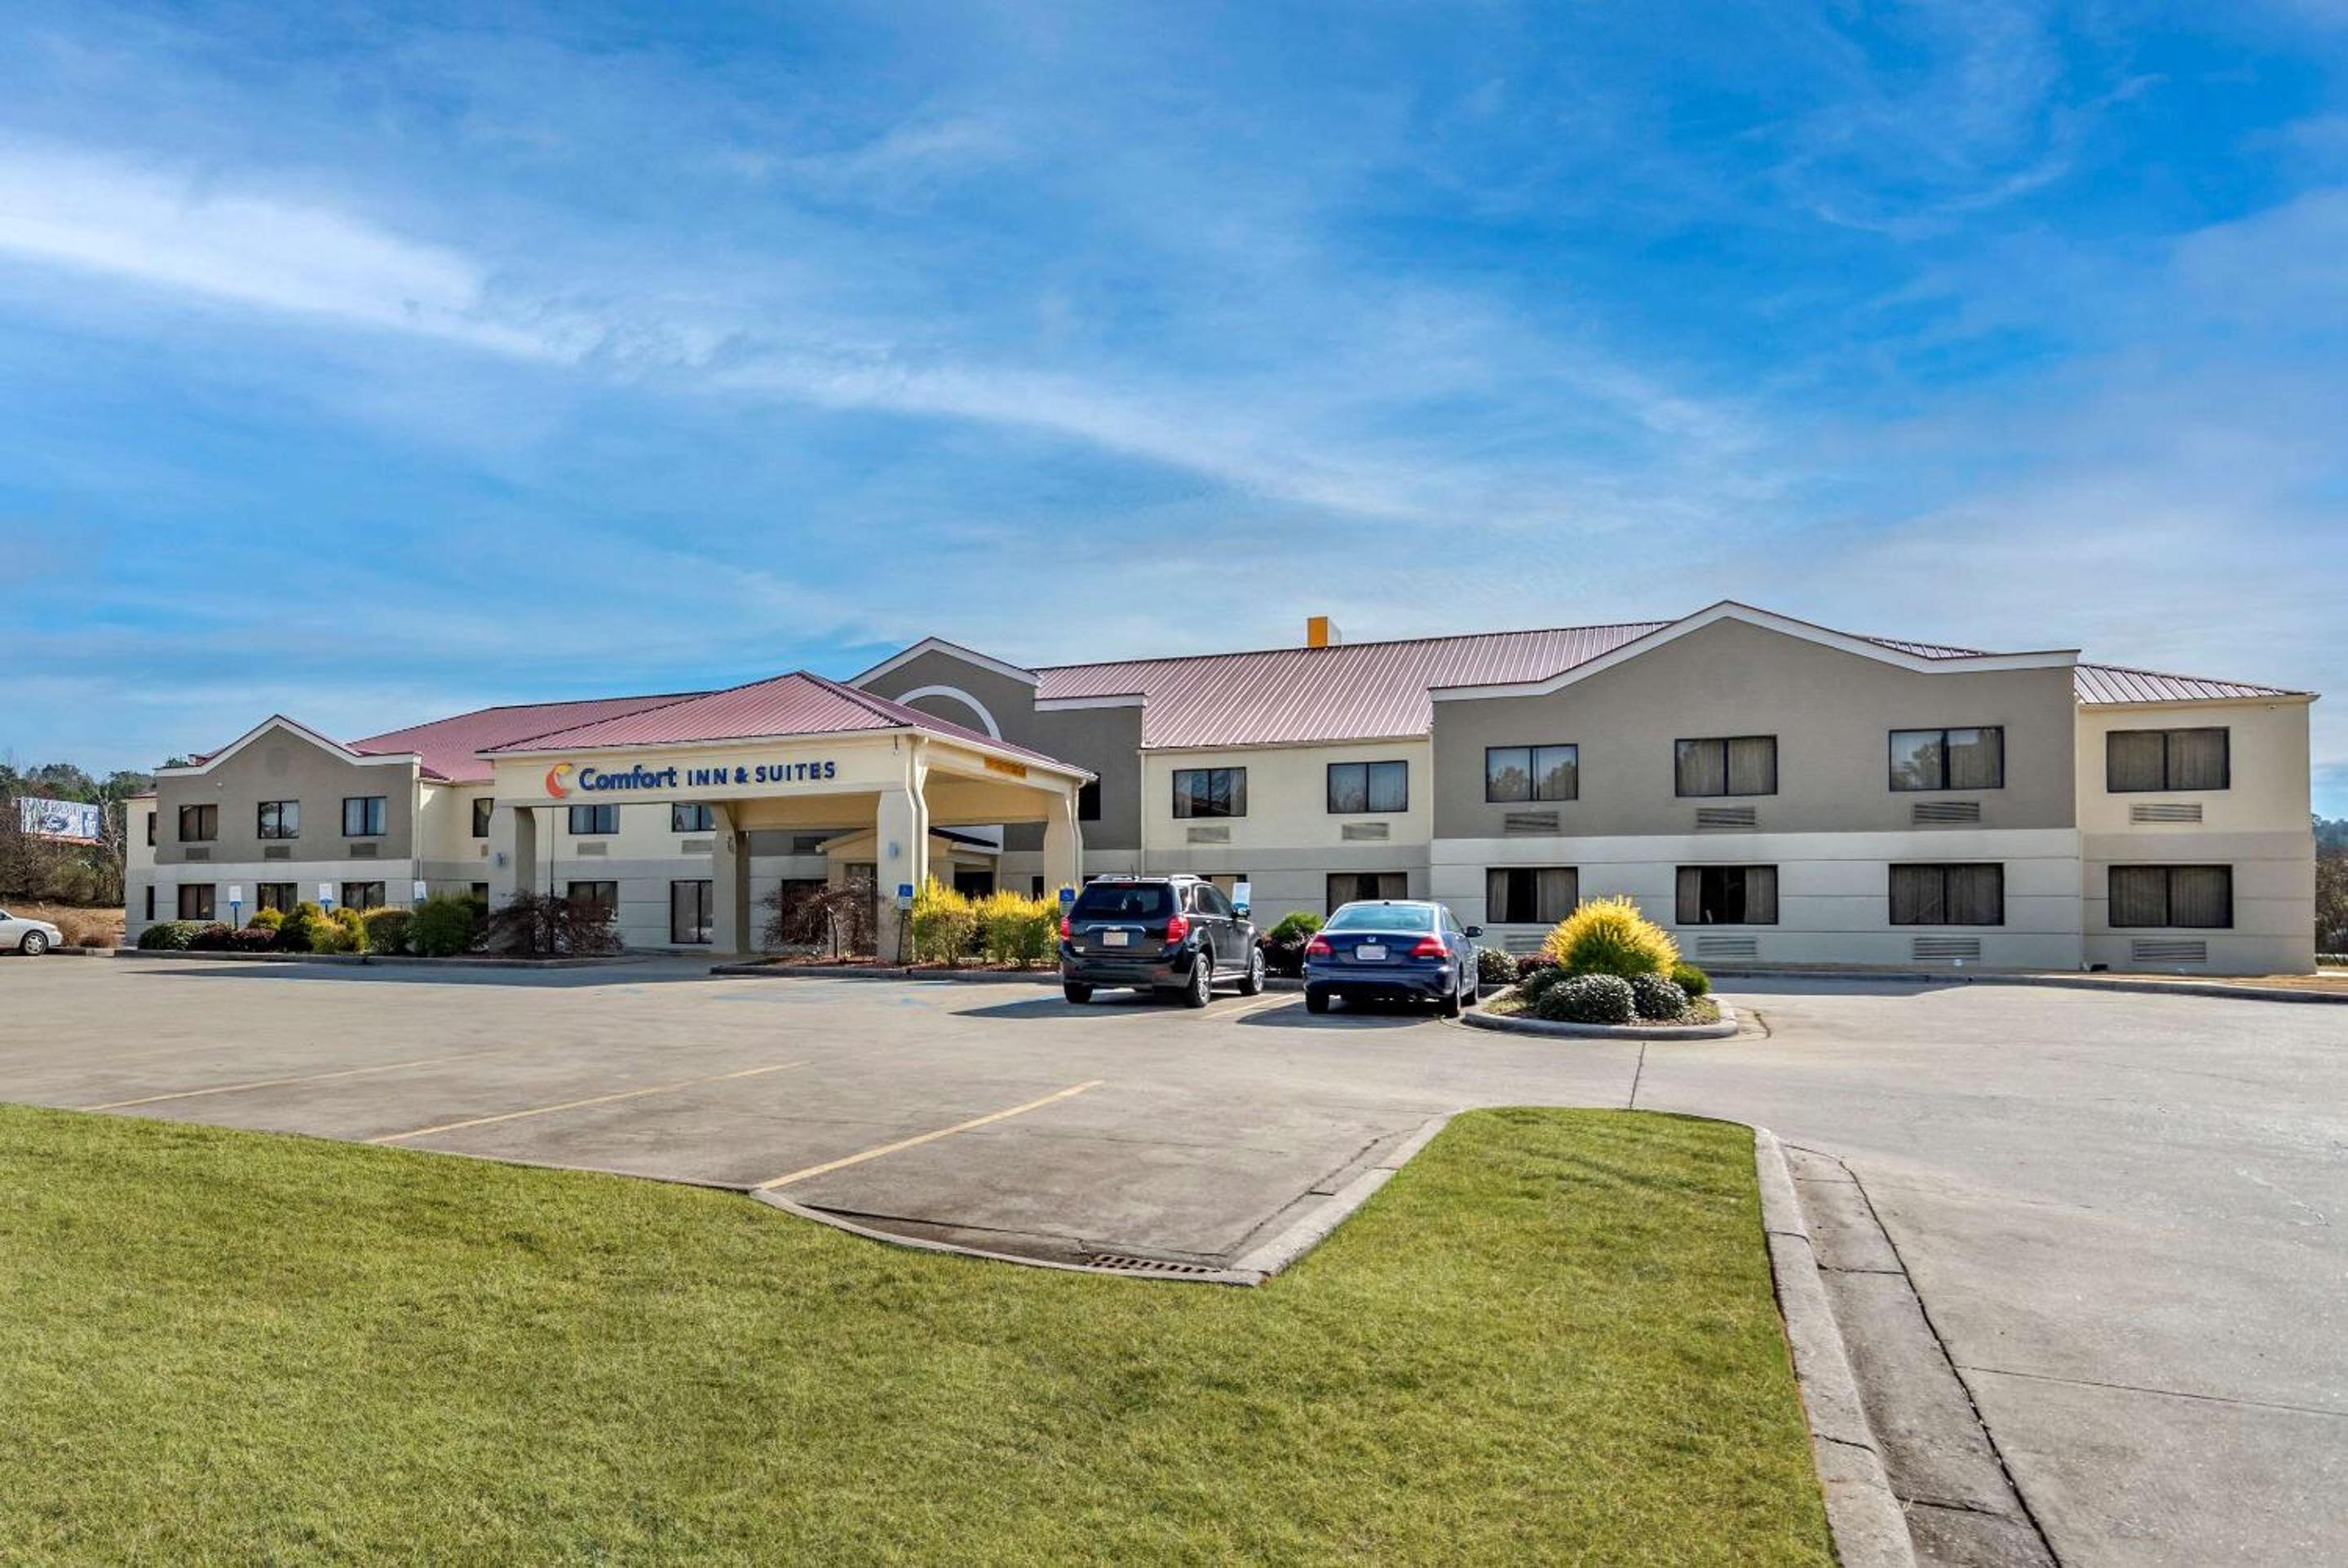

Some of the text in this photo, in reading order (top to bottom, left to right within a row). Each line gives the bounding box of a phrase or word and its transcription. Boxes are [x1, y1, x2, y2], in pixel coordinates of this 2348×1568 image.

[579, 761, 836, 791] Comfort INN & SUITES
